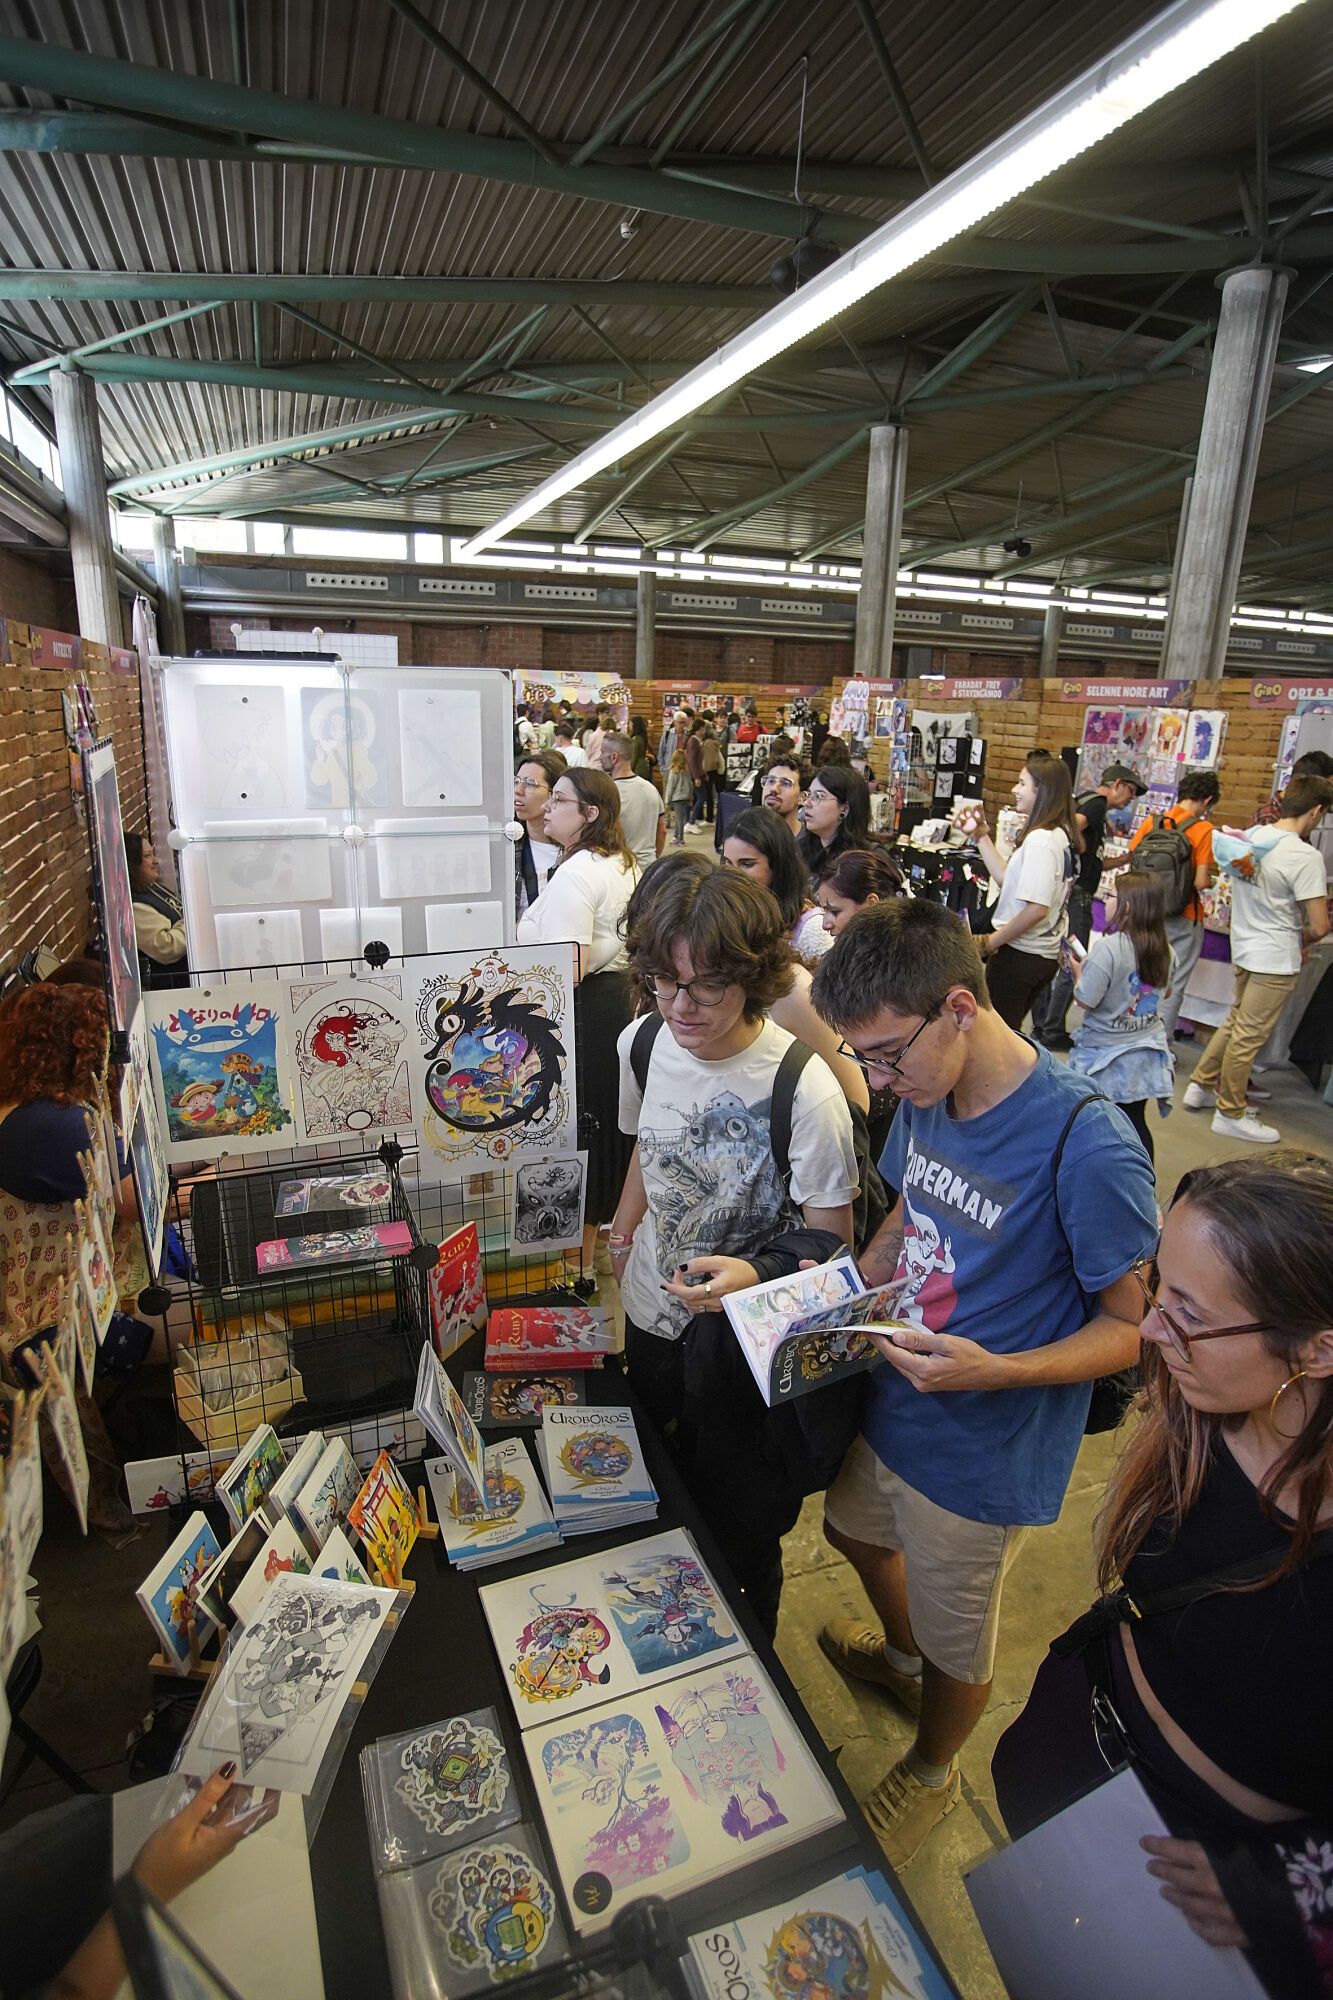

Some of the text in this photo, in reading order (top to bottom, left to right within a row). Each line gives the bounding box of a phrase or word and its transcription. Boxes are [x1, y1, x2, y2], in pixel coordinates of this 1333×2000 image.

[1086, 685, 1169, 699] SELENNE NORE ART
